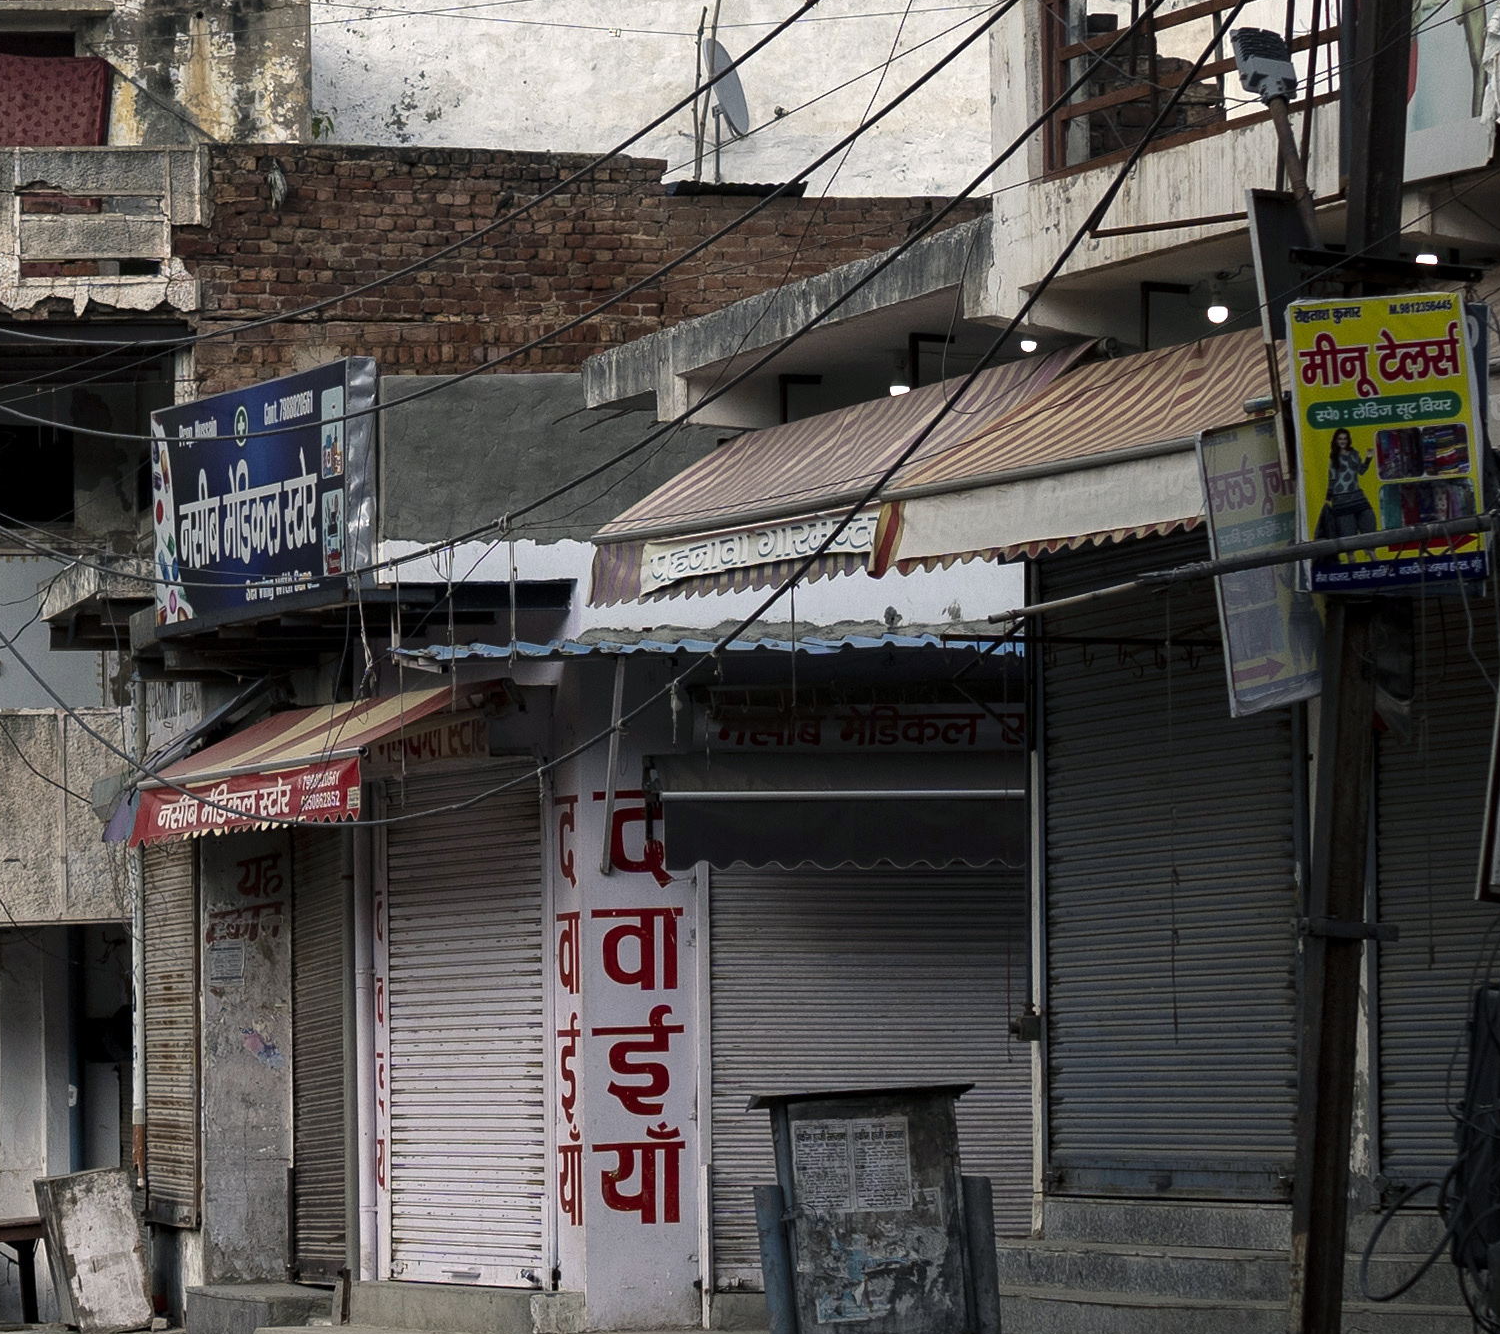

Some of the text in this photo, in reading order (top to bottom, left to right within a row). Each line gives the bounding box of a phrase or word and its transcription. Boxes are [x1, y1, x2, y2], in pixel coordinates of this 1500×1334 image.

[1332, 306, 1362, 324] कुमार
[1298, 320, 1461, 399] मीनू टेलर्स
[1395, 402, 1418, 419] सूट
[1419, 396, 1453, 412] वियर
[179, 446, 317, 569] नसीब मेडिकल स्टोर
[157, 776, 293, 830] नसीब मेडिकल स्टोर
[237, 853, 283, 897] यह
